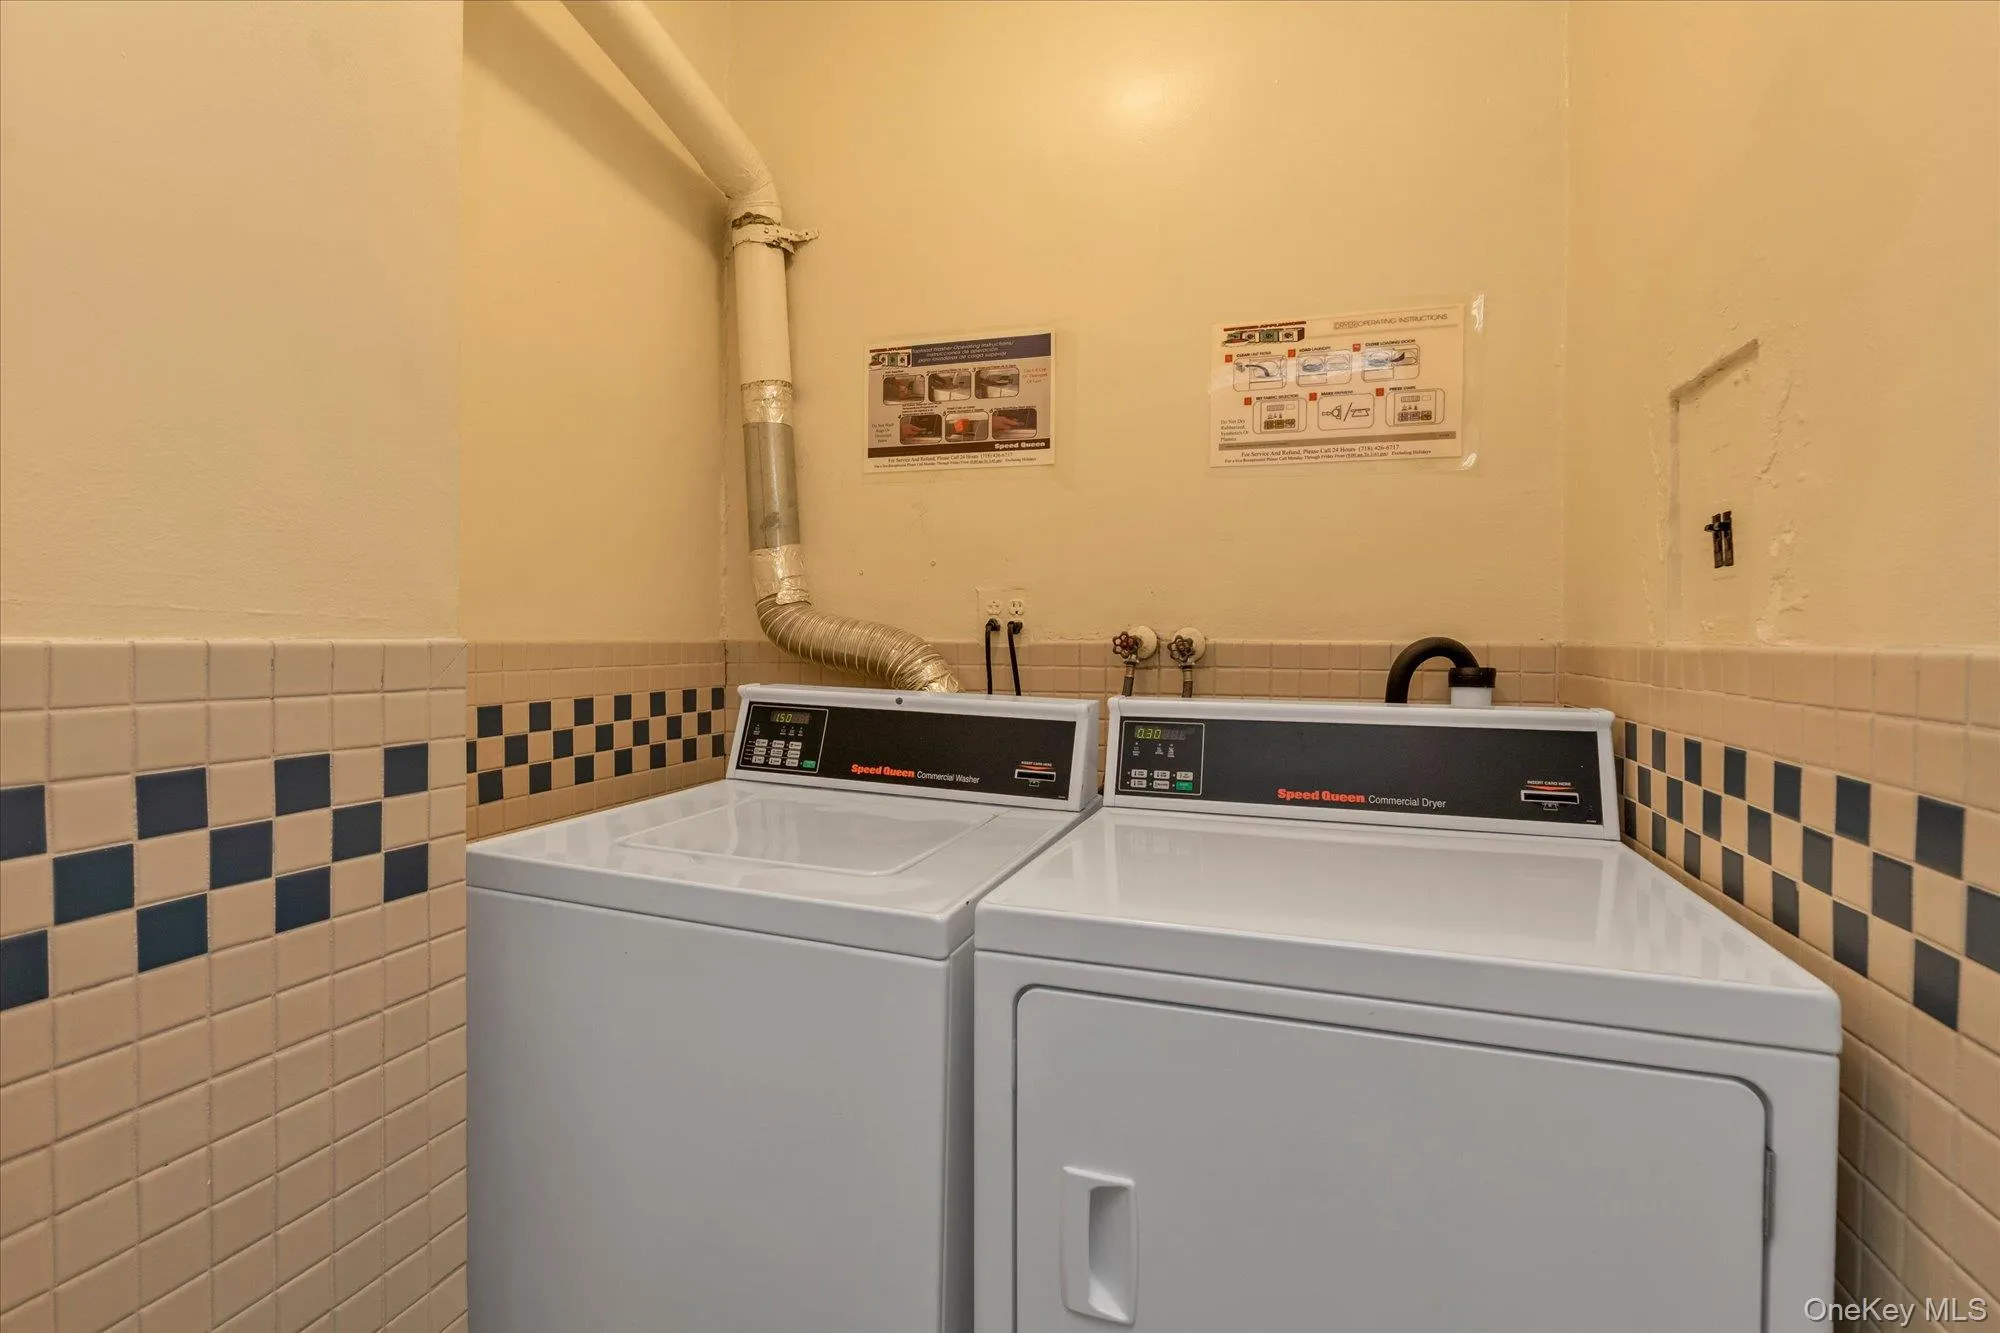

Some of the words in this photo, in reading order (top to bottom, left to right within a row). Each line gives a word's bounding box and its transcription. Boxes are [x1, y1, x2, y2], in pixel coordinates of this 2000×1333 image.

[1359, 317, 1396, 327] OPERATING
[1399, 313, 1448, 323] INSTRUCTIONS
[994, 442, 1019, 450] Speed
[851, 764, 882, 775] Speed
[883, 766, 915, 778] Queen
[916, 770, 955, 782] Commercial
[955, 774, 980, 784] Washer
[1277, 788, 1320, 801] Speed
[1321, 790, 1366, 804] Queen
[1368, 795, 1419, 807] Commercial
[1421, 798, 1446, 810] Dryer
